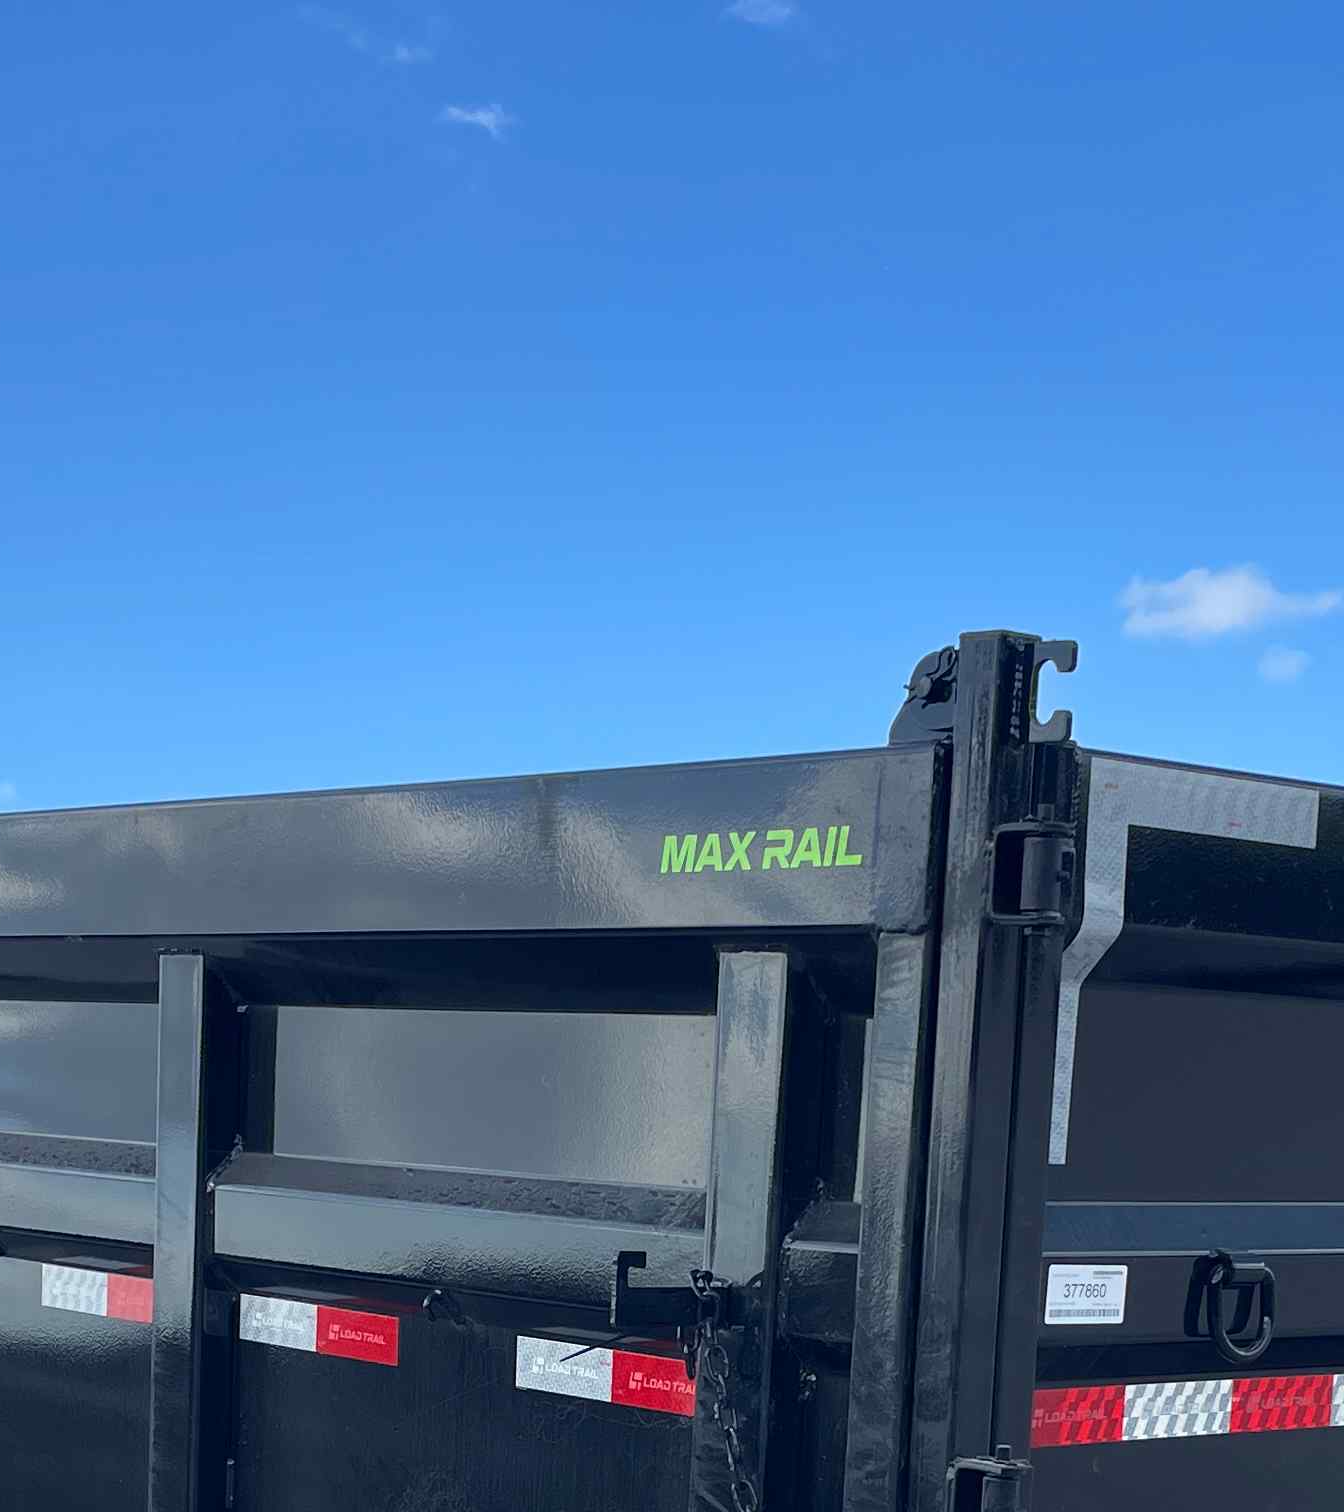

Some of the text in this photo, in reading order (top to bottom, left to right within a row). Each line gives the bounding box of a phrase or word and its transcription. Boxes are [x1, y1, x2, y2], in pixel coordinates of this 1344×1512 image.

[660, 825, 863, 874] MAX RAIL
[1064, 1283, 1107, 1298] 377860
[340, 1328, 387, 1345] LOAD TRAIL
[643, 1377, 670, 1391] LOAD
